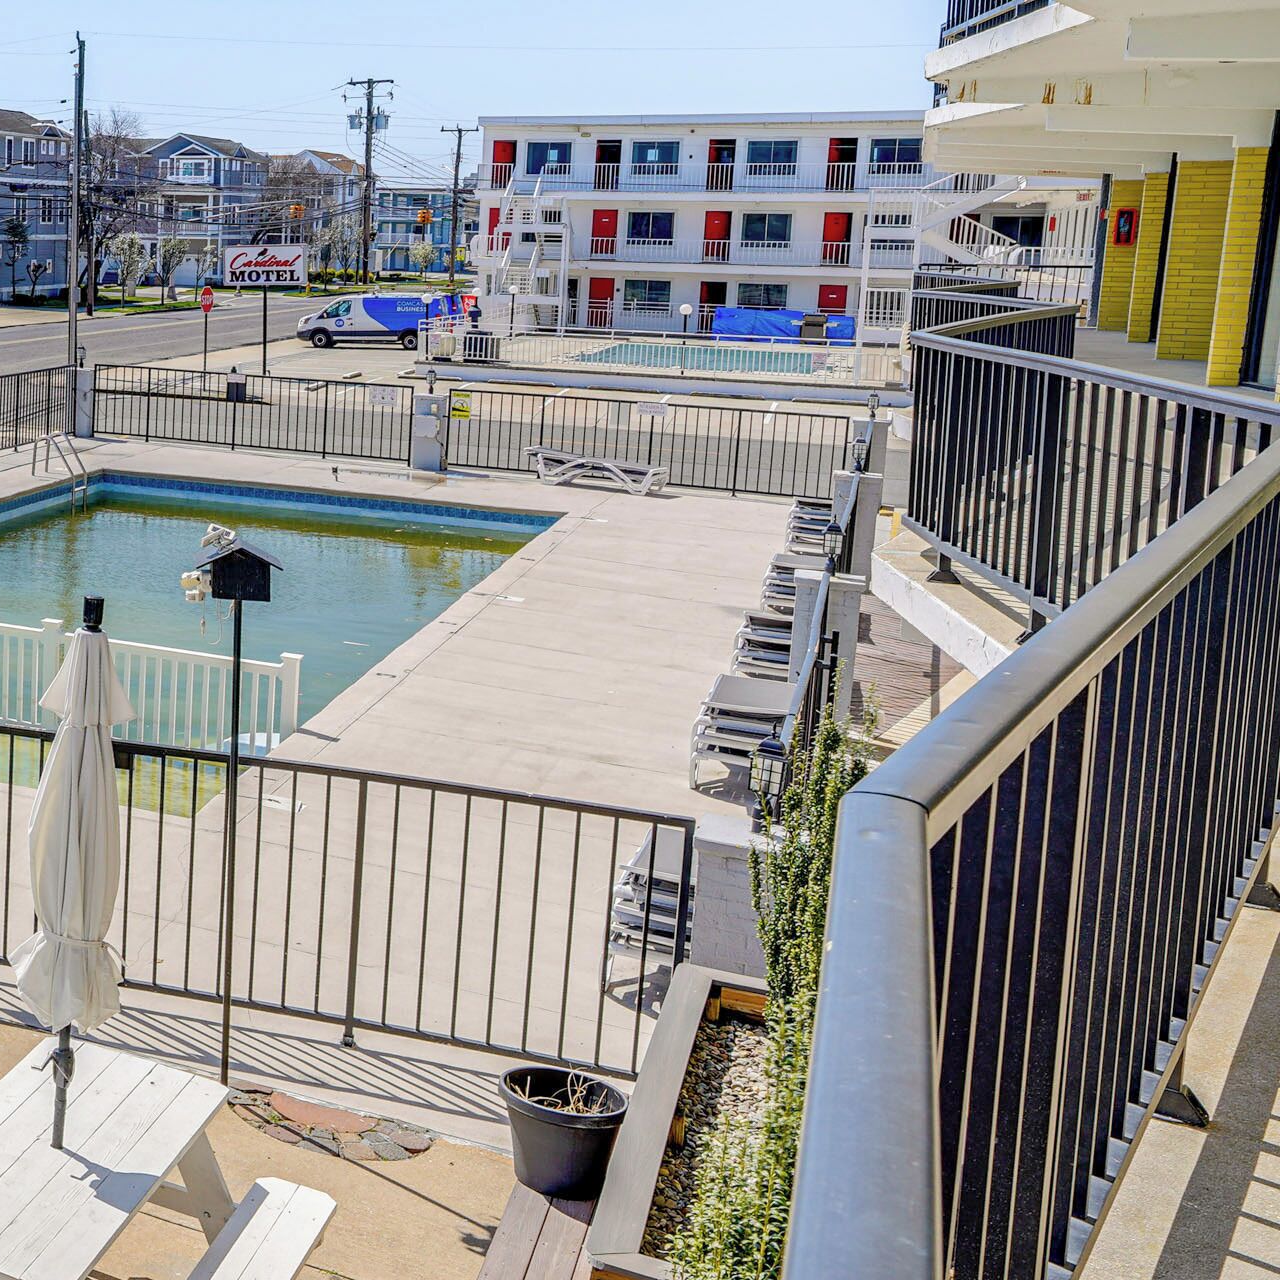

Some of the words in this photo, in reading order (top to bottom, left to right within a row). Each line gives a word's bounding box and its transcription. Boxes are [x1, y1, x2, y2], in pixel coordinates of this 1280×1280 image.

[230, 252, 302, 270] Cardinal
[229, 270, 300, 282] MOTEL
[200, 294, 214, 306] STOP
